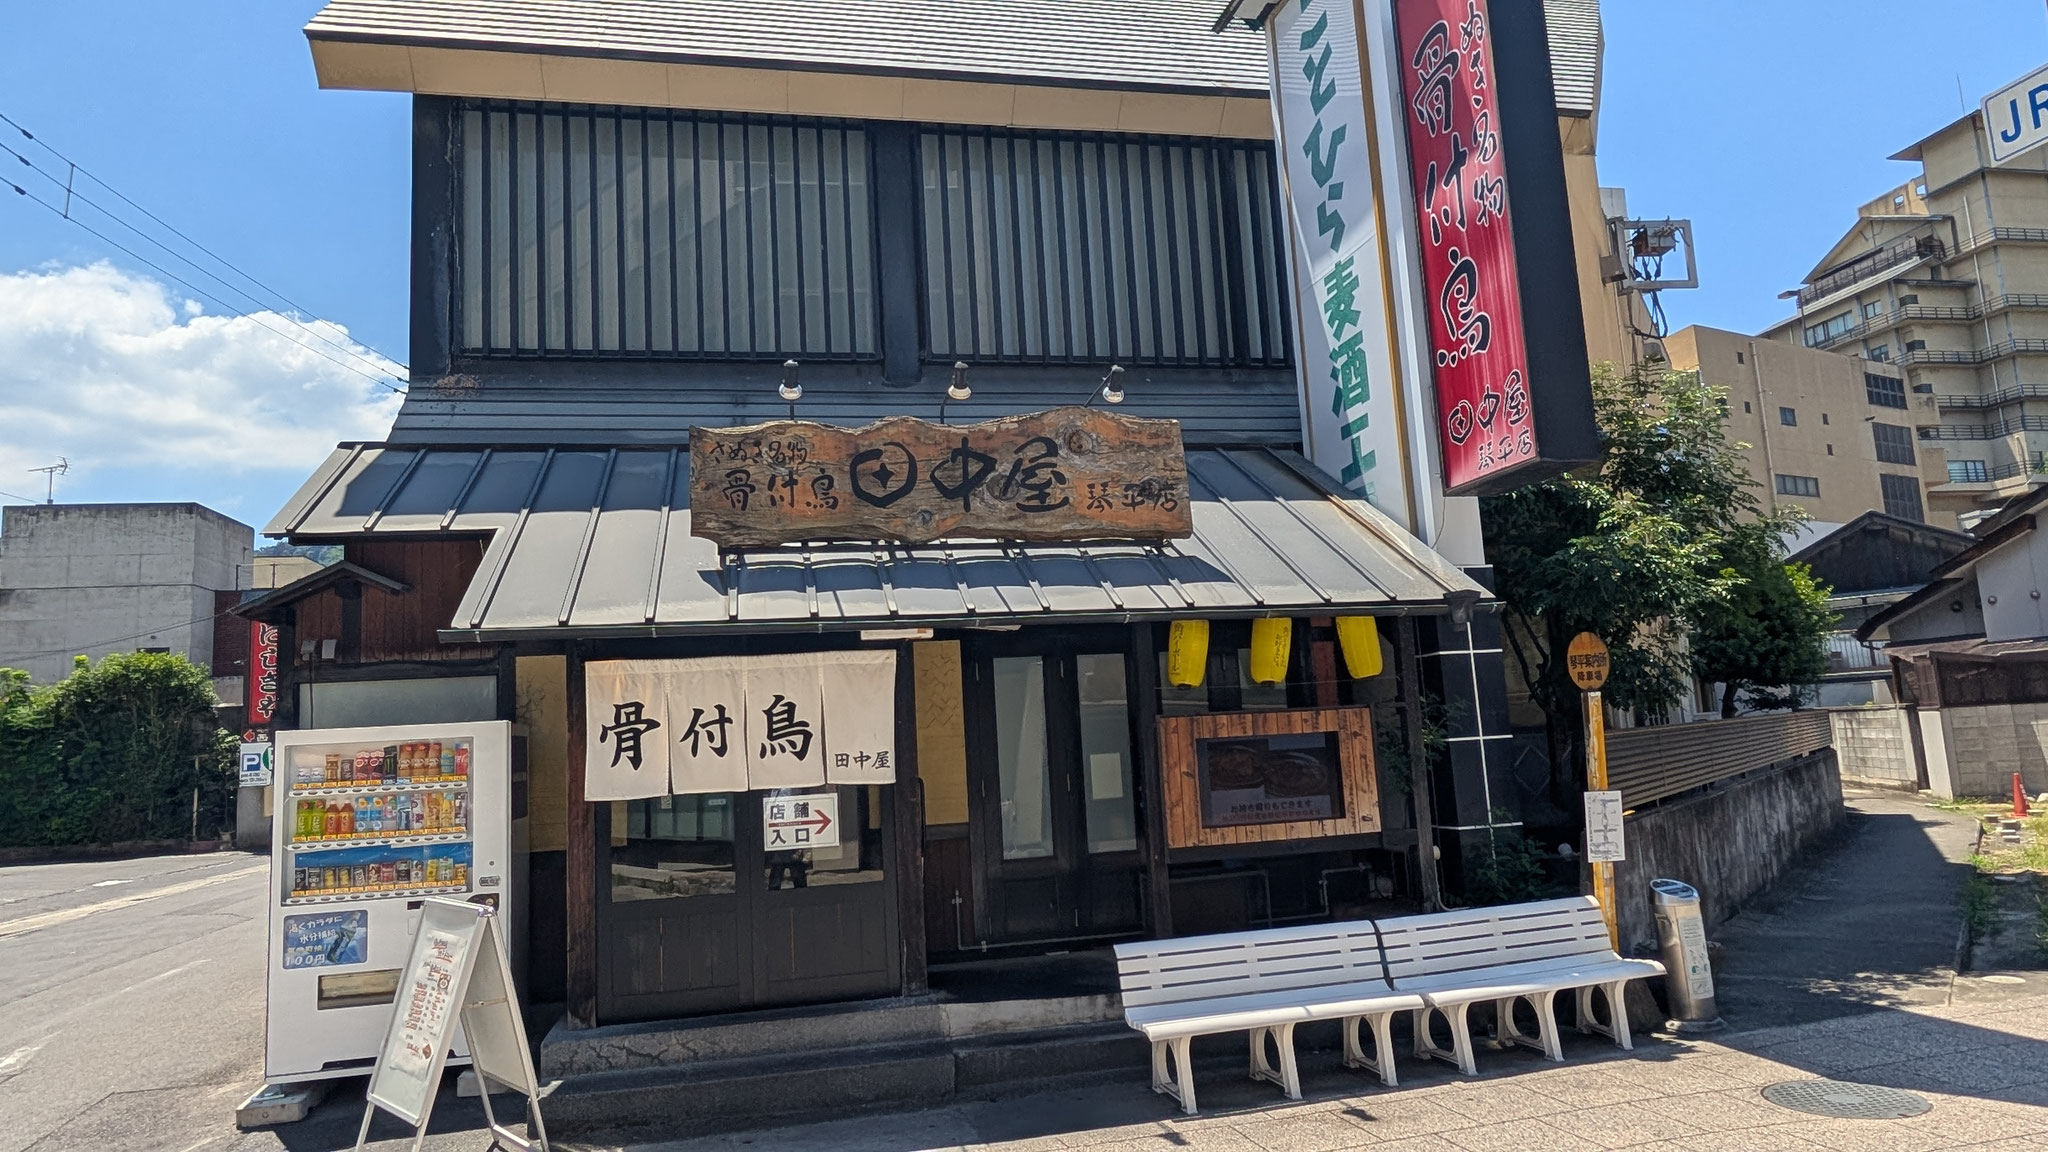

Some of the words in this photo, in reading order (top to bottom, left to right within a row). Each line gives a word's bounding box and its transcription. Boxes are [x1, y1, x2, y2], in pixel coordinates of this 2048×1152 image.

[2000, 83, 2048, 144] JR
[1412, 20, 1492, 368] 骨付鳥
[1447, 369, 1529, 445] 田中屋
[709, 440, 808, 465] さぬき名物
[1478, 426, 1533, 471] 琴平店
[722, 468, 840, 512] 骨付鳥
[849, 436, 1070, 513] 田中屋
[1086, 480, 1180, 513] 琴平店
[599, 694, 814, 772] 骨付鳥
[243, 754, 260, 771] P
[834, 750, 891, 770] 田中屋
[770, 802, 810, 820] 店舗
[770, 828, 810, 846] 入口
